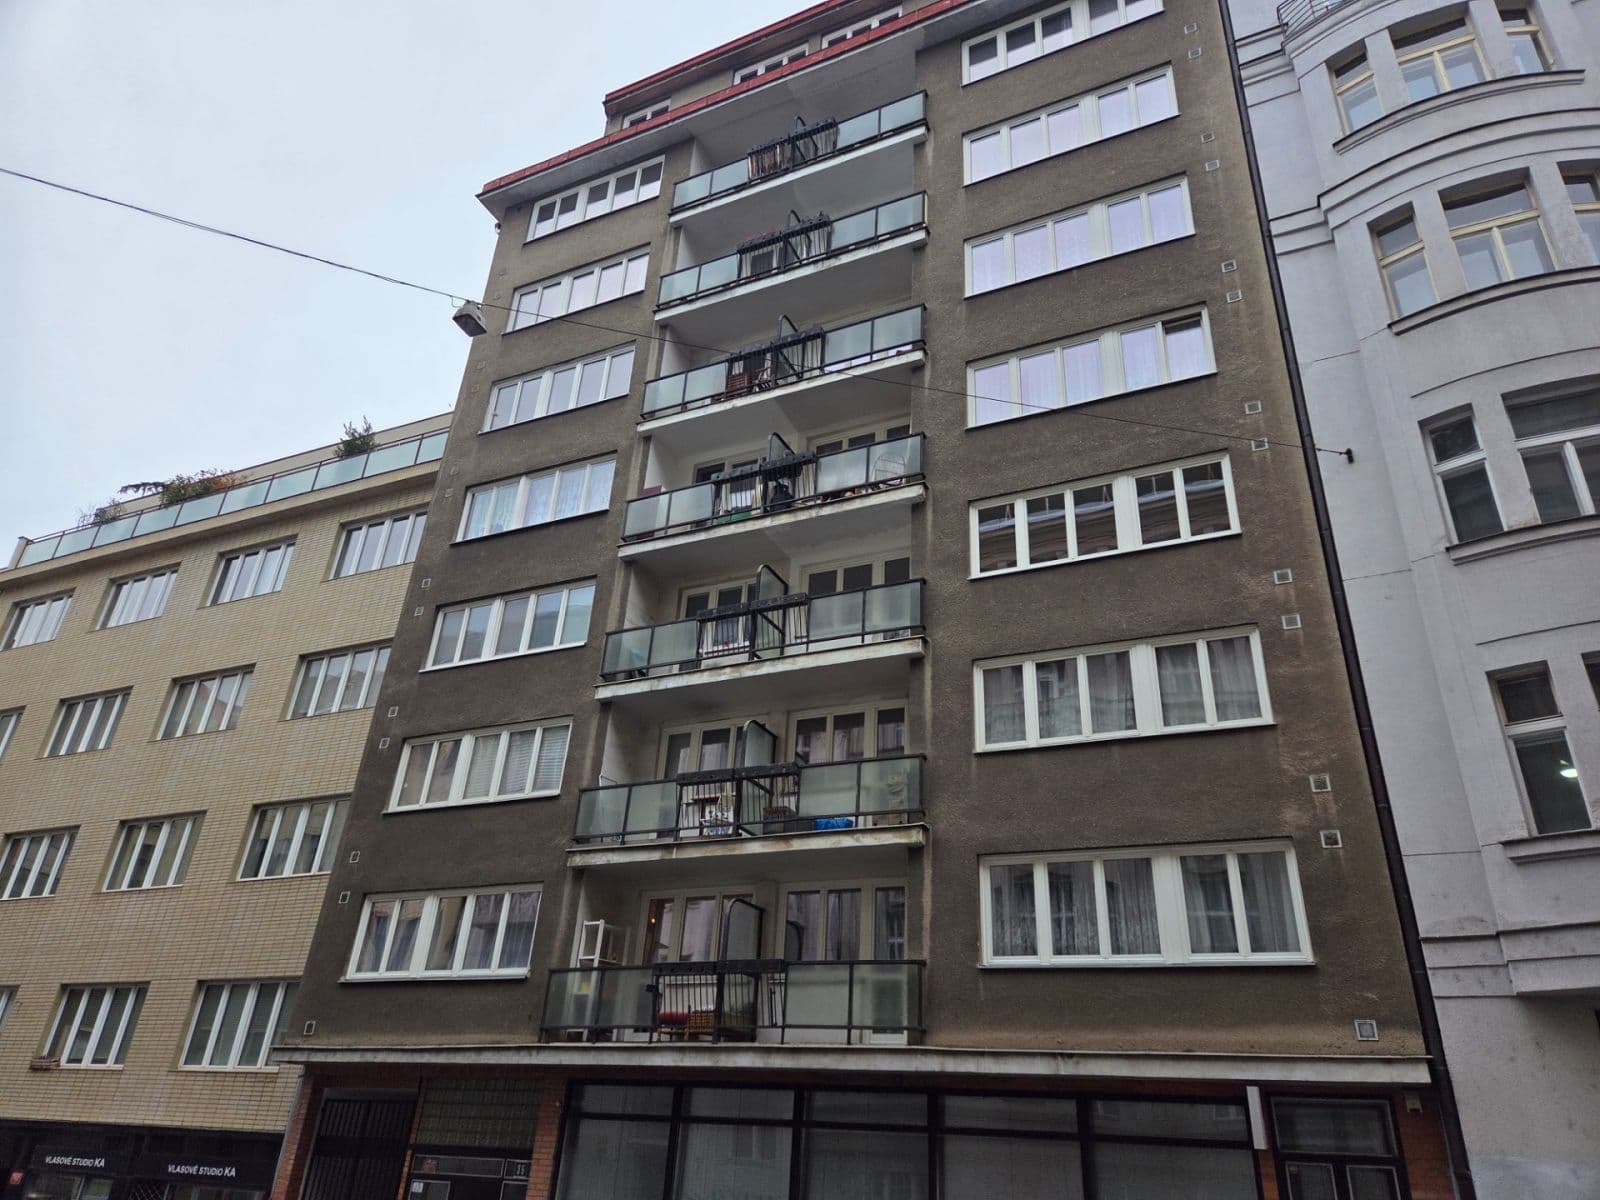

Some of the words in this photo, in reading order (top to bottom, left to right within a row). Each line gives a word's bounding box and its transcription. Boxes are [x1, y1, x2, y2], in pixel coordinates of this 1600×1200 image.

[72, 1157, 93, 1167] STUDIO
[94, 1157, 105, 1168] KA
[198, 1166, 223, 1176] STUDIO
[223, 1166, 236, 1177] KA
